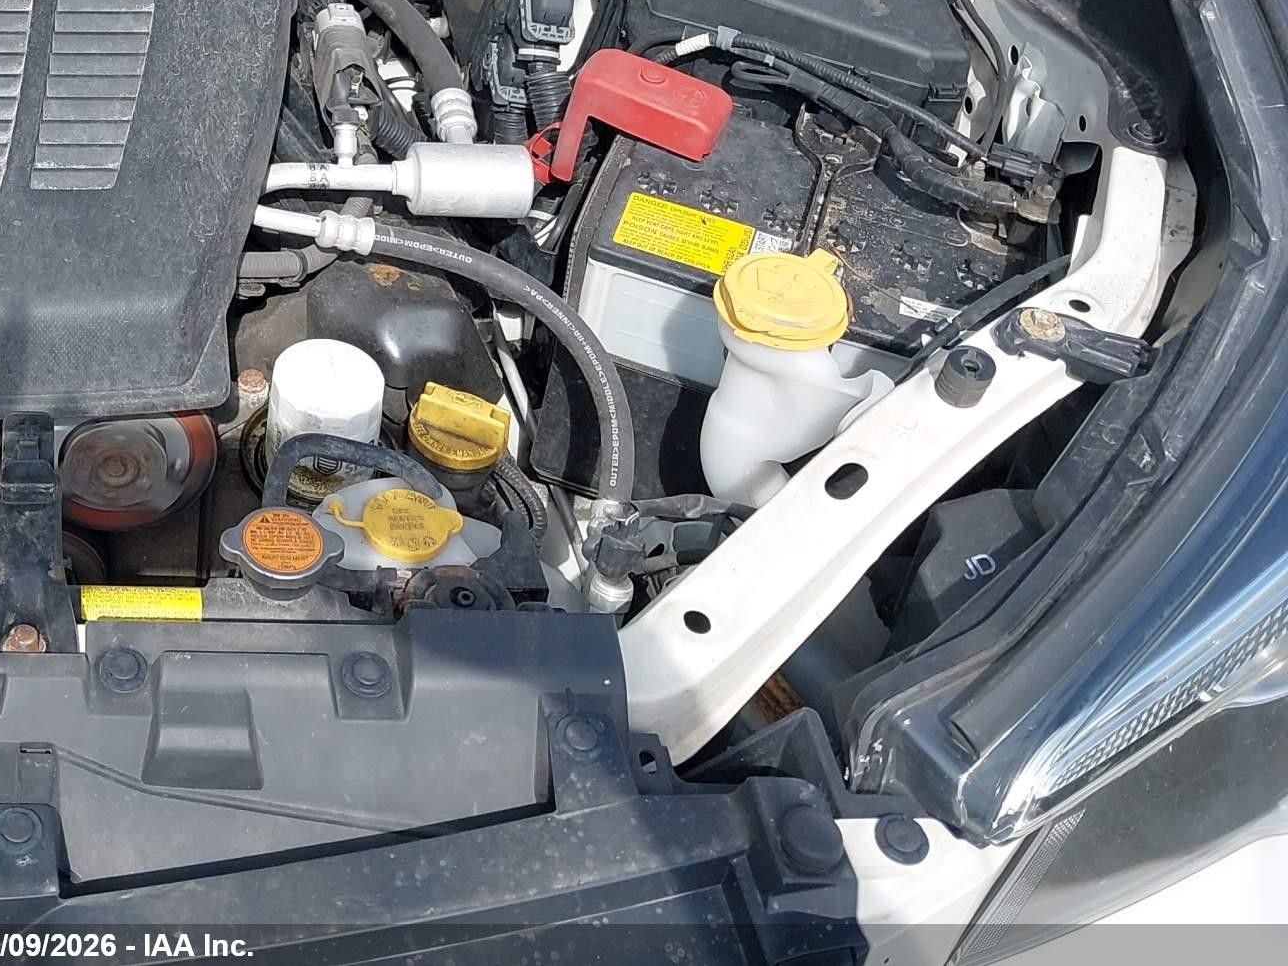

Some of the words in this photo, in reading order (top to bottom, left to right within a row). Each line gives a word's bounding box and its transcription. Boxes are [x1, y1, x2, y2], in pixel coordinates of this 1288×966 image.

[633, 195, 668, 209] DANGER
[622, 220, 657, 235] POISON
[964, 553, 996, 580] JD
